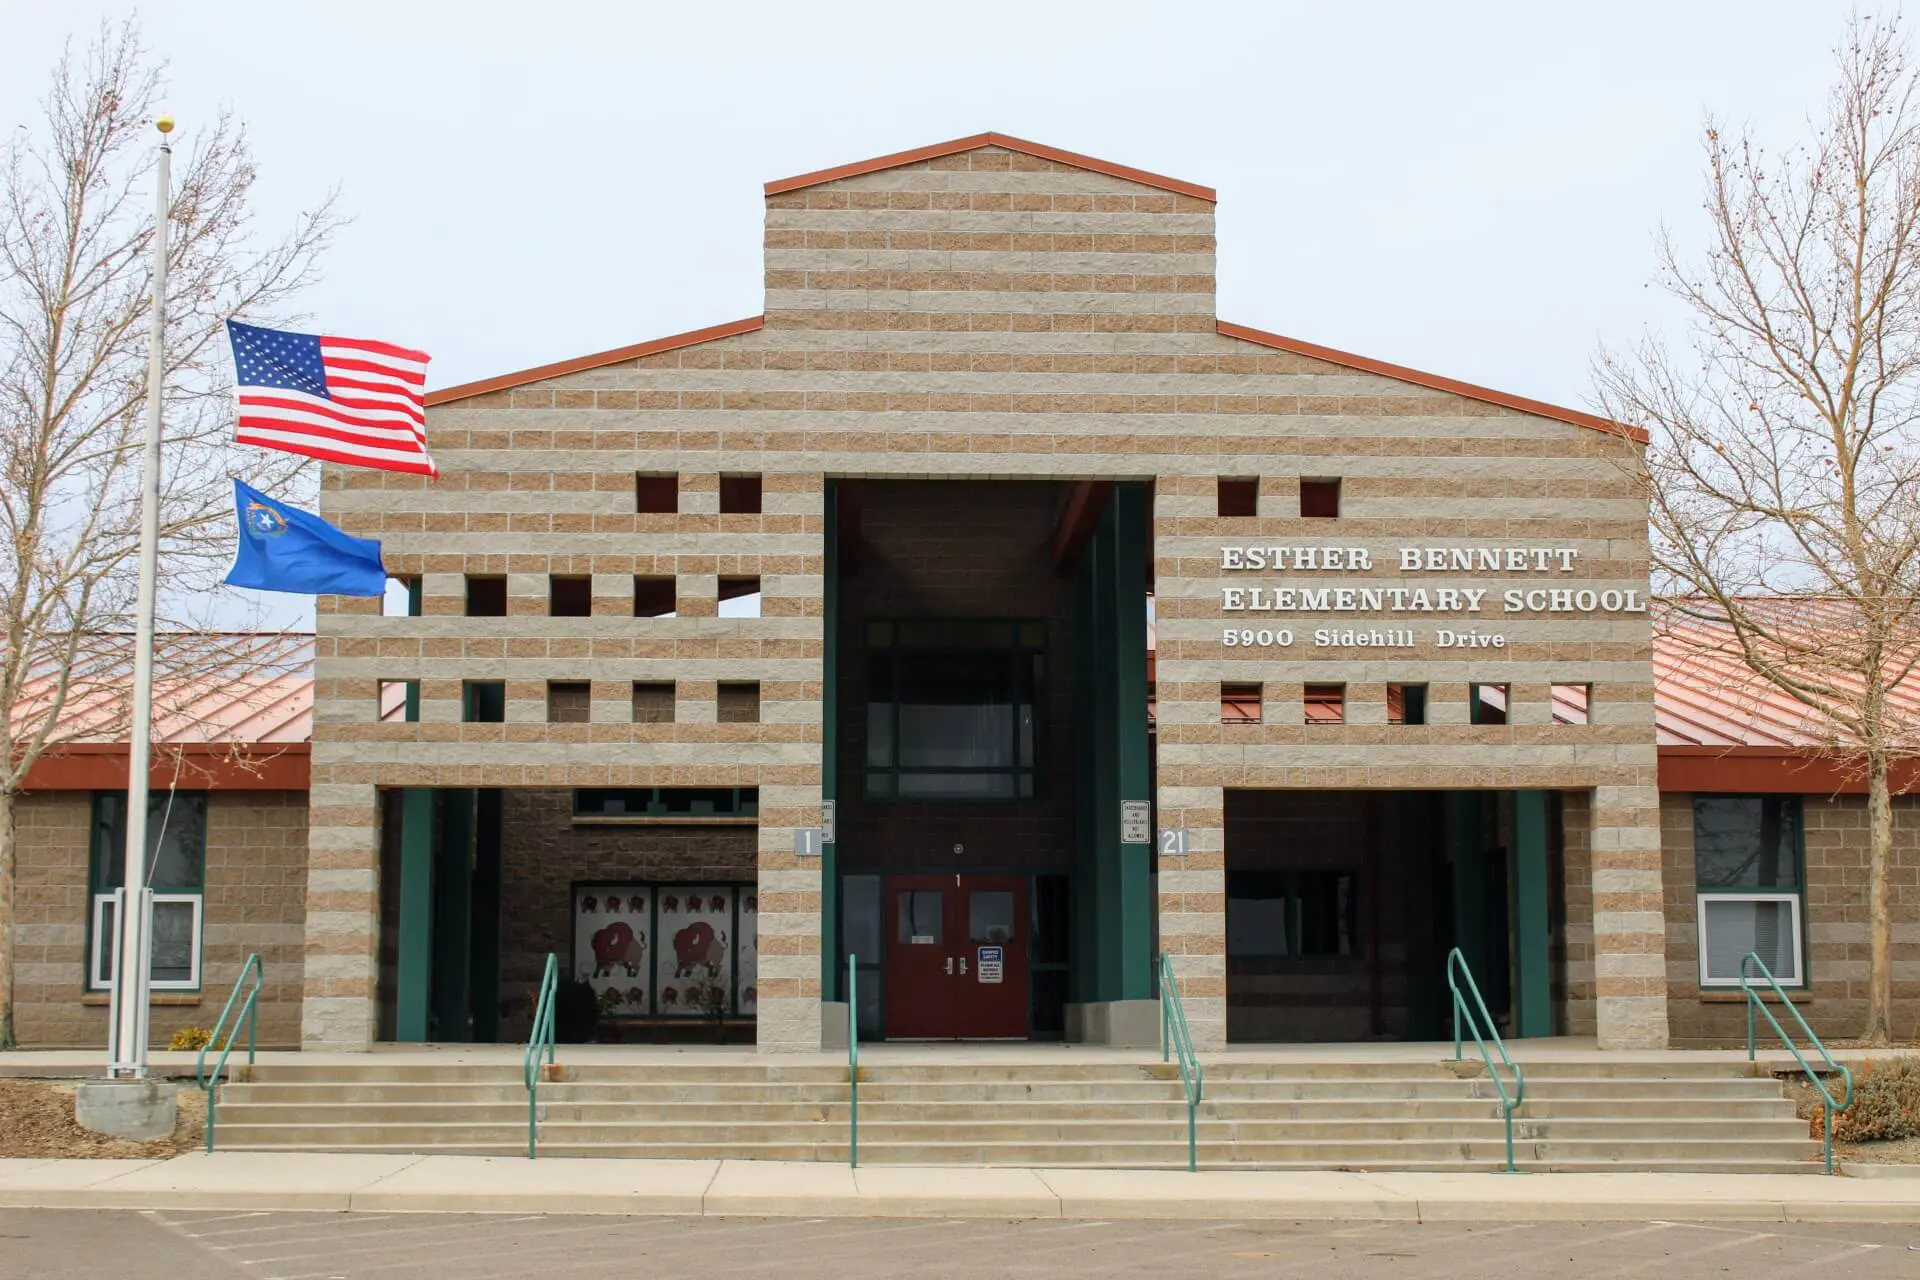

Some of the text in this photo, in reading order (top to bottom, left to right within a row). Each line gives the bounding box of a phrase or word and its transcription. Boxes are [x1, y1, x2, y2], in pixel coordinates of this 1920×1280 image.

[1220, 546, 1578, 572] ESTHER BENNETT
[1221, 587, 1647, 612] ELEMENTARY SCHOOL
[1222, 628, 1506, 649] 5900 Sidehill Drive
[805, 831, 811, 853] 1
[1163, 830, 1183, 853] 21
[956, 874, 961, 887] 1
